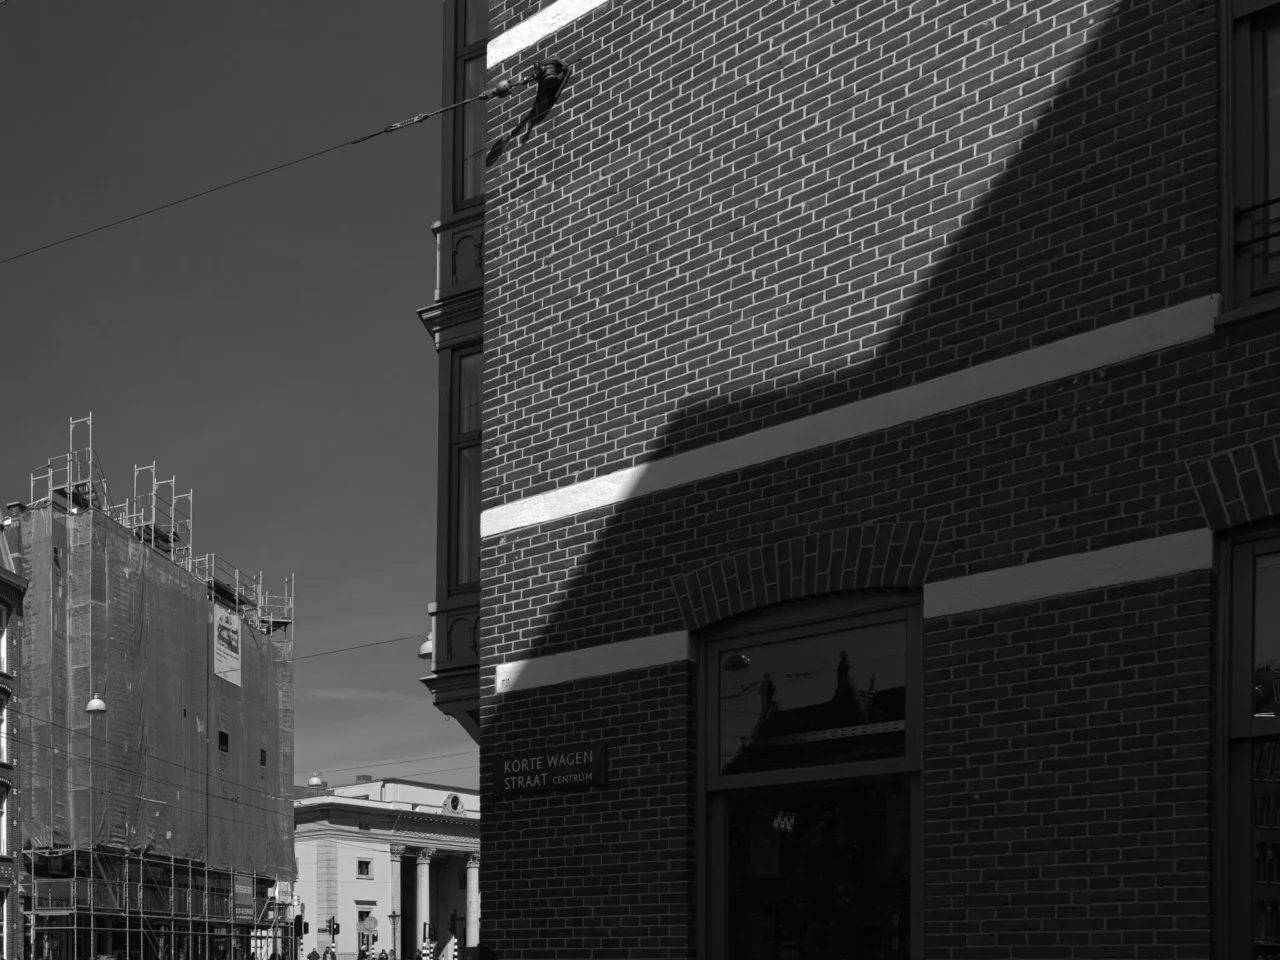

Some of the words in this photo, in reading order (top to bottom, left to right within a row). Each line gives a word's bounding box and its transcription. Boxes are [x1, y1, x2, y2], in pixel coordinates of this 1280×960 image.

[504, 756, 543, 773] KORTE
[546, 750, 593, 768] WAGEN
[504, 772, 548, 790] STRAAT
[552, 772, 593, 785] CENTRUM
